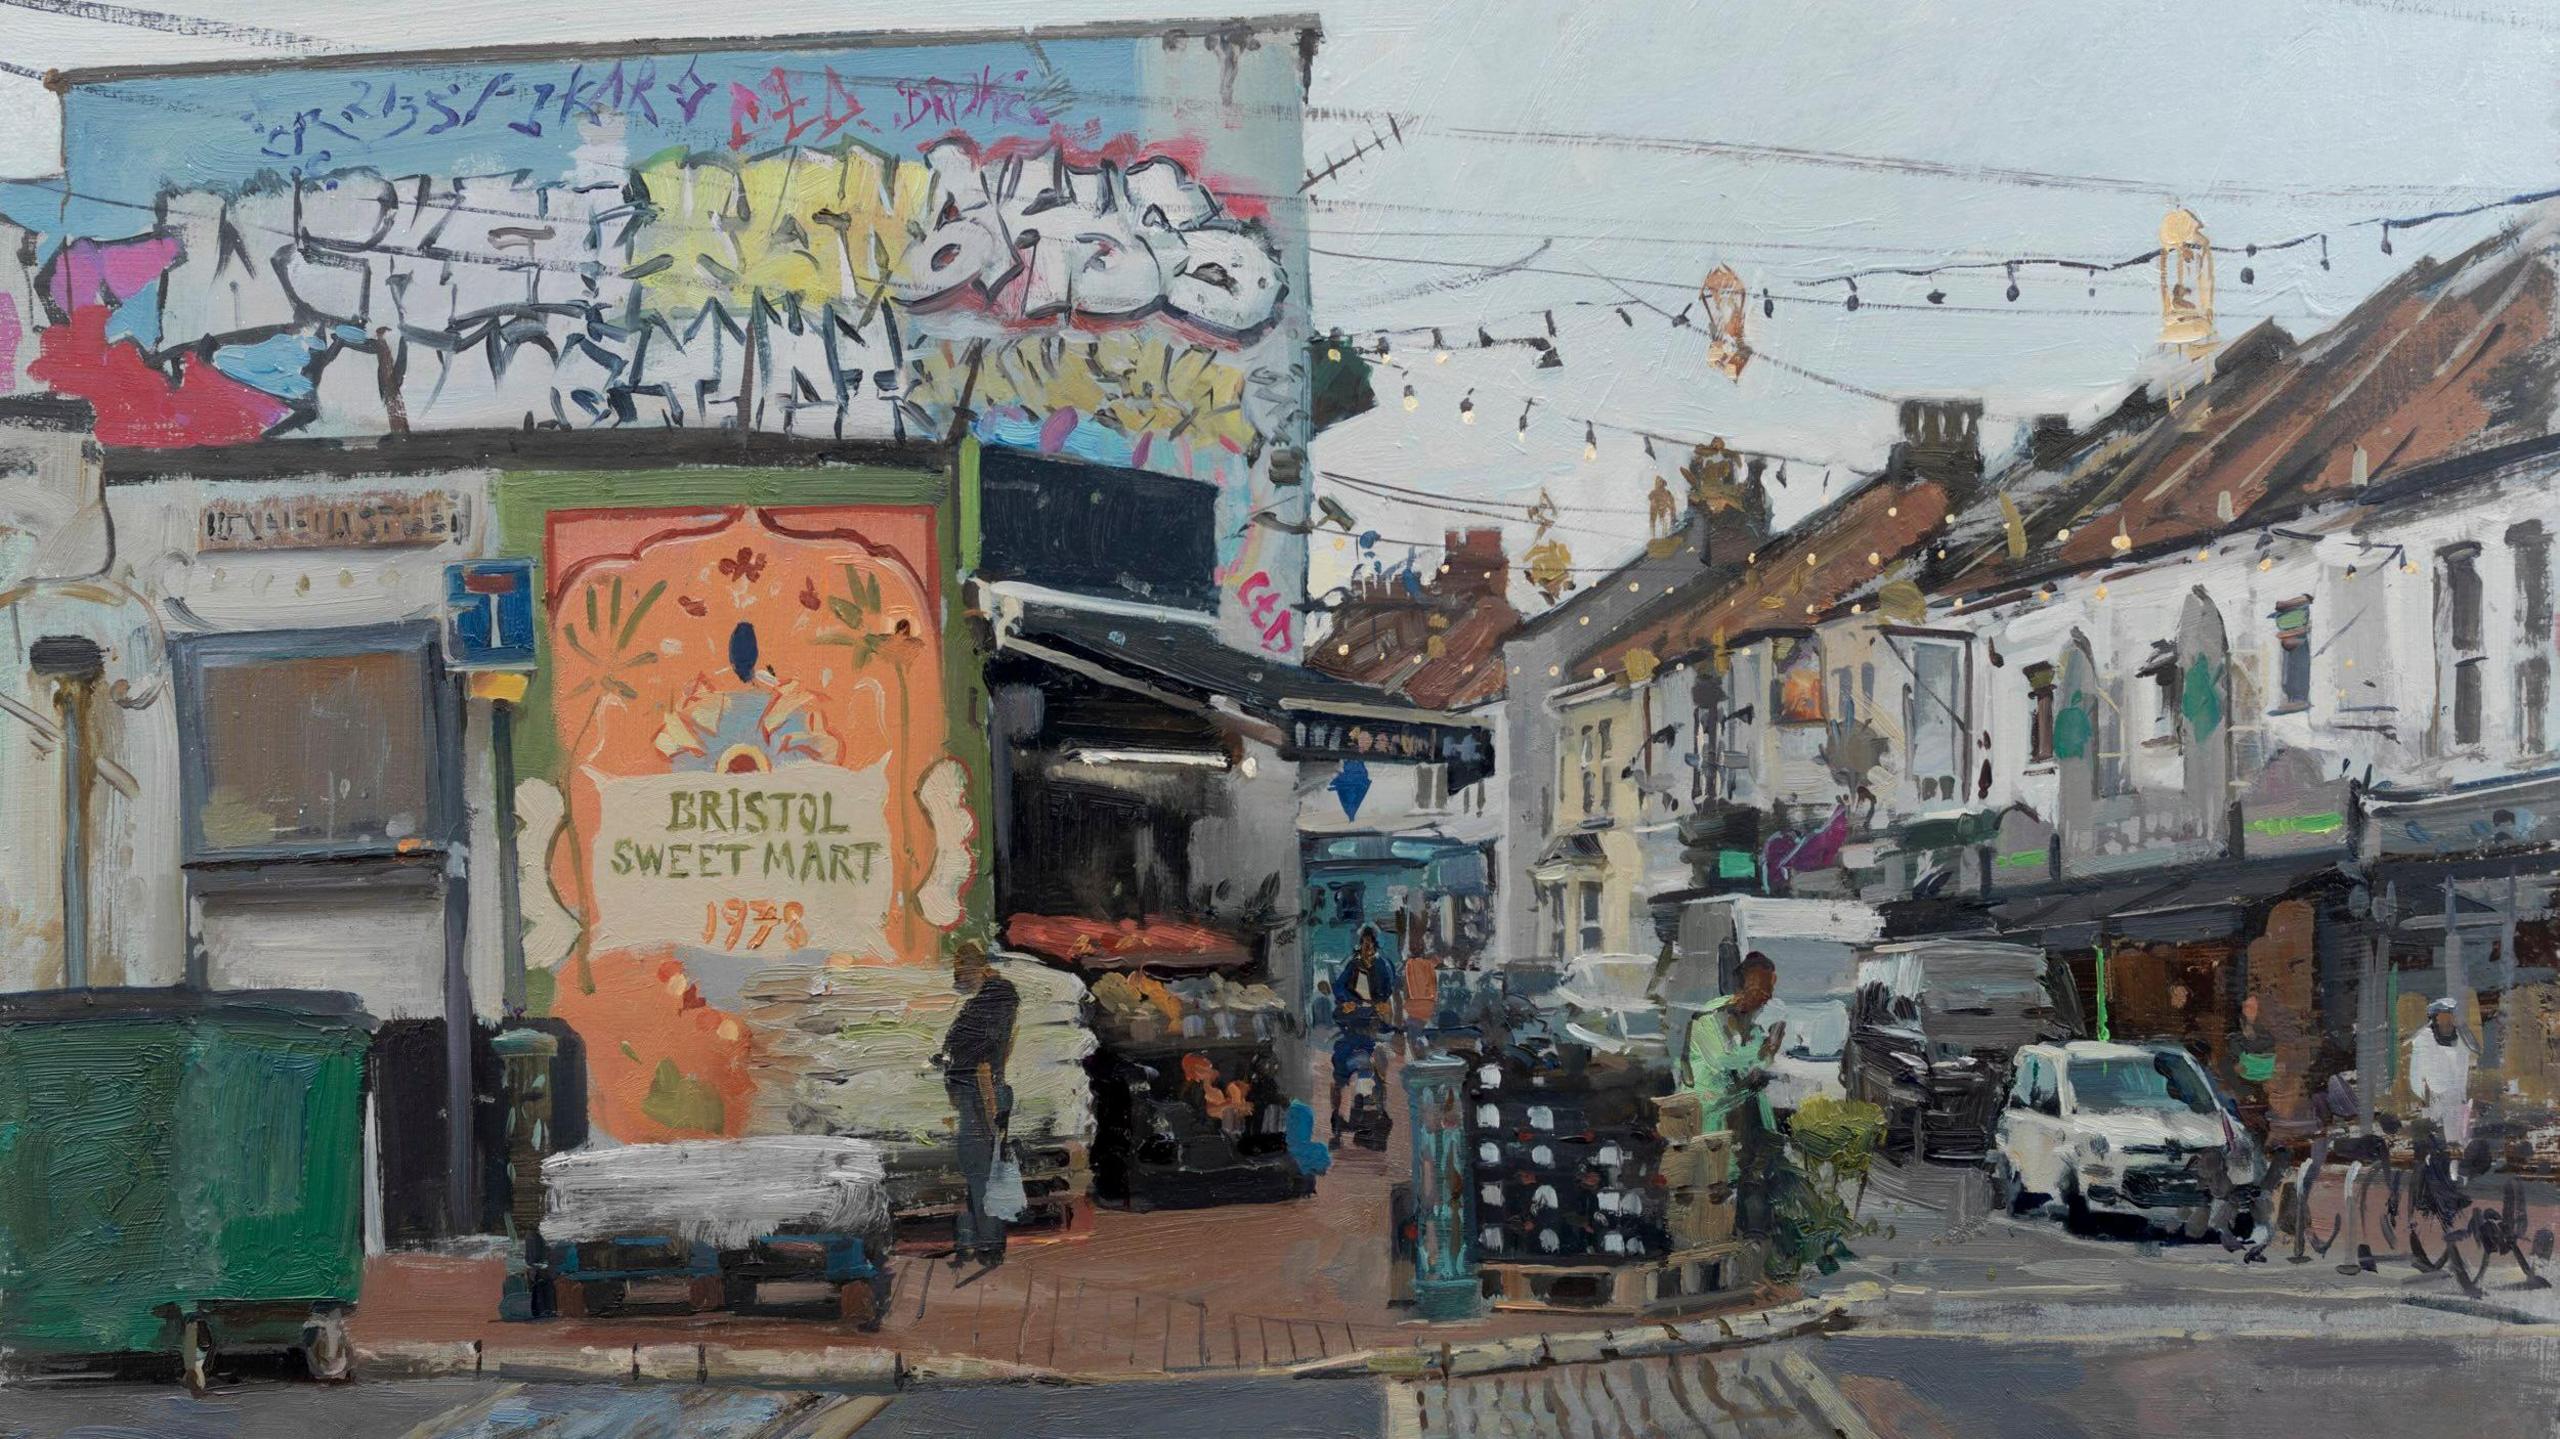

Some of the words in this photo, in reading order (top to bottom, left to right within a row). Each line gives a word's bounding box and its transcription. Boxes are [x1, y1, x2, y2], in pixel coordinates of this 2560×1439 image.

[666, 788, 849, 834] BRISTOL
[610, 838, 755, 879] SWEET
[762, 840, 884, 887] MART
[702, 898, 809, 950] 1978
